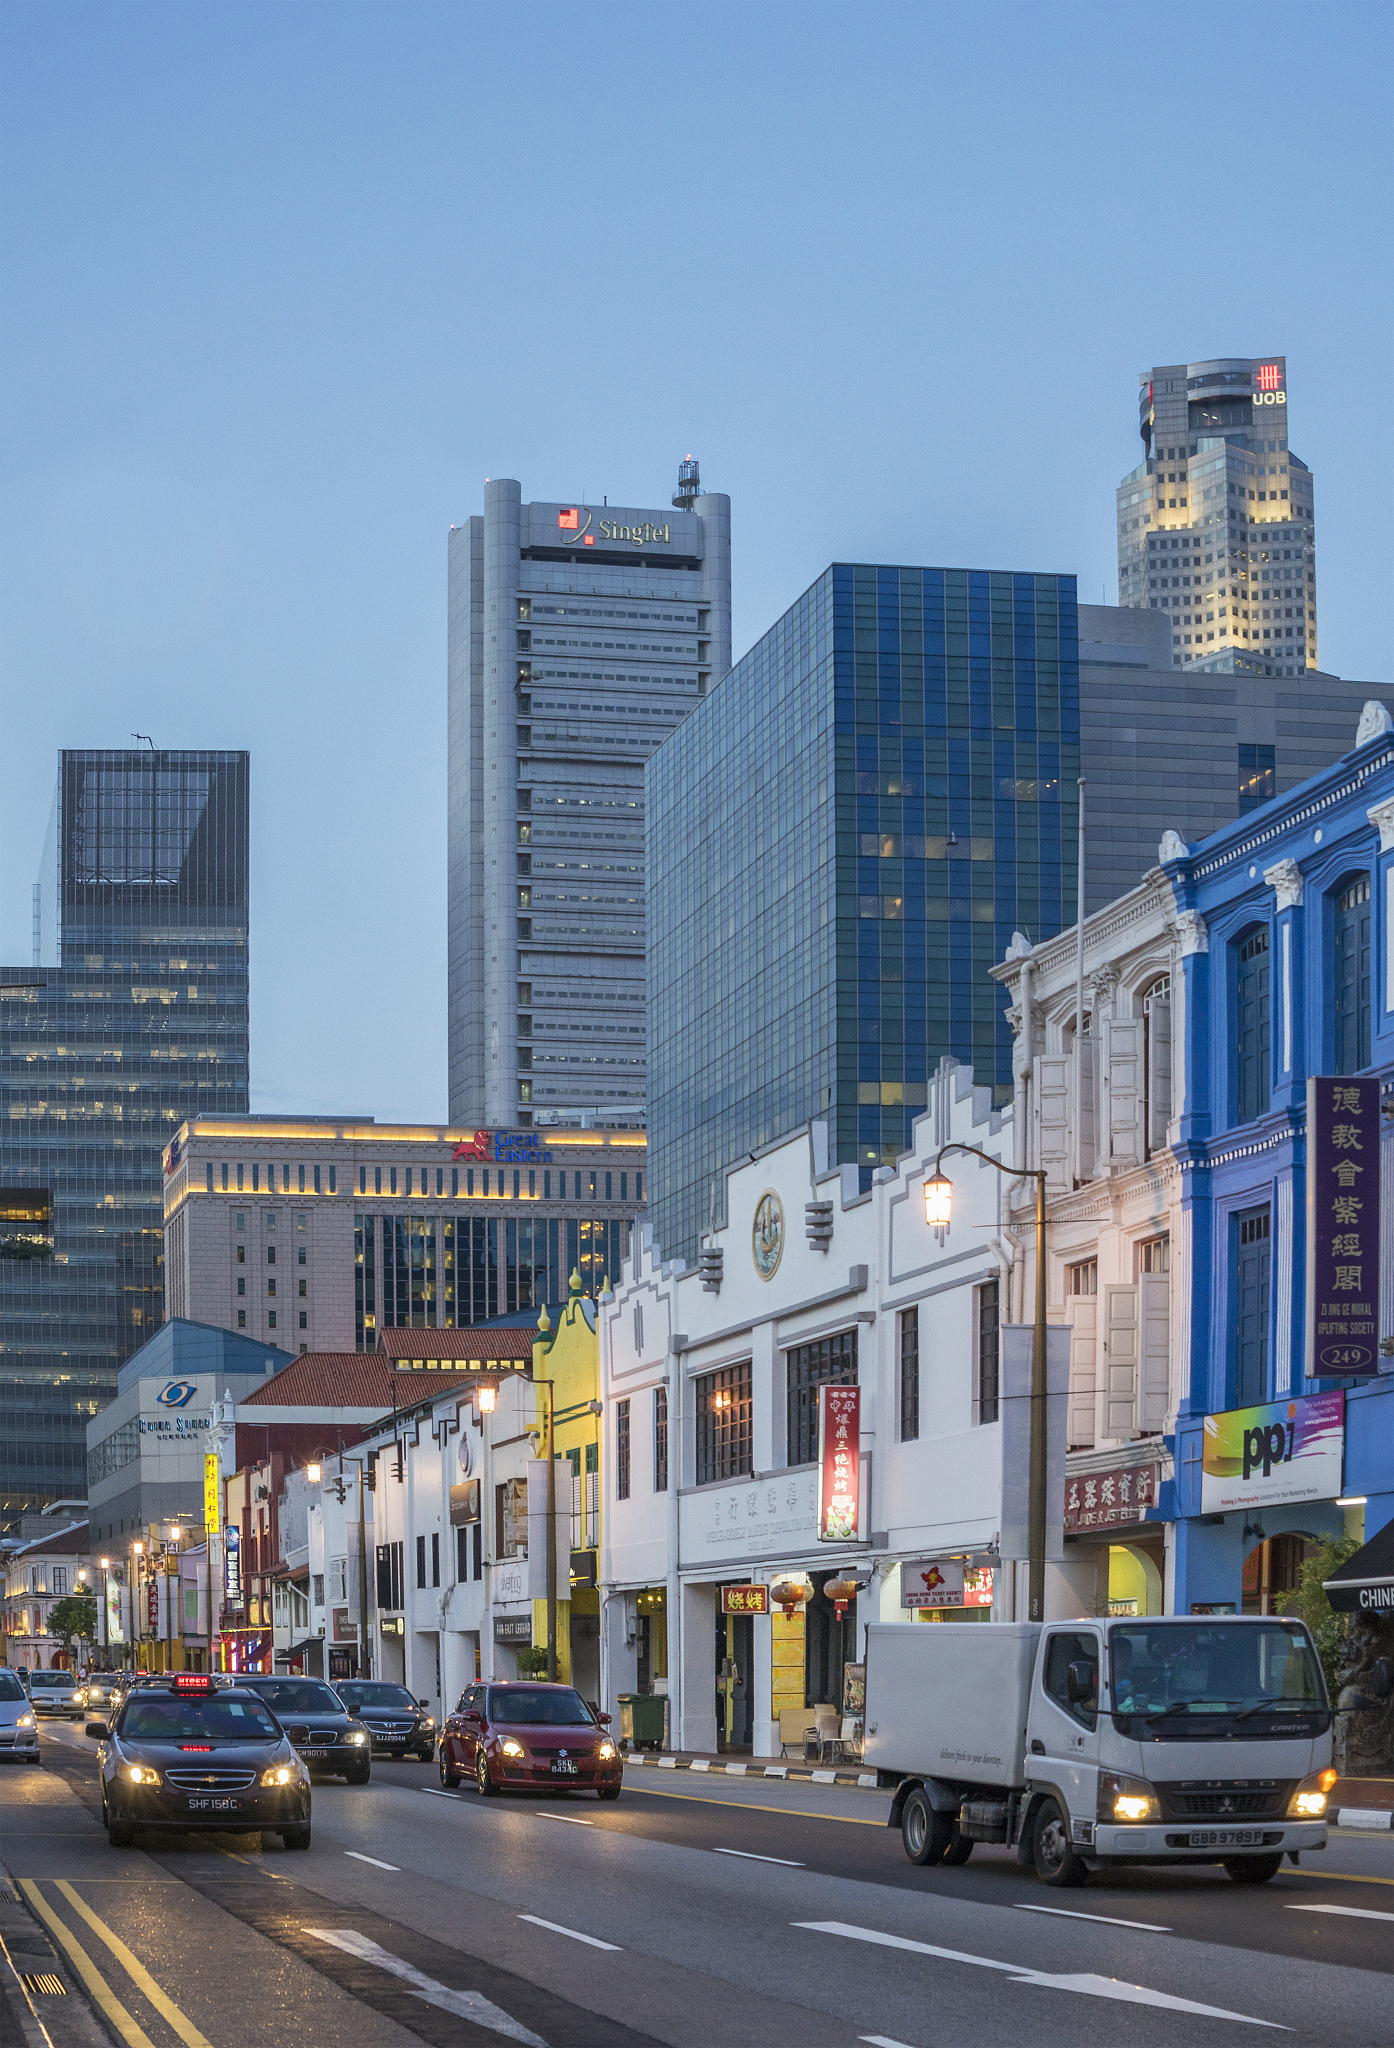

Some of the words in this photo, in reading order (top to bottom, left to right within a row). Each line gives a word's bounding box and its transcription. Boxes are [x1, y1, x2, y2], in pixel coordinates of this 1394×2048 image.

[1252, 391, 1287, 406] UOB
[599, 520, 671, 546] SingTel
[495, 1130, 538, 1147] Great
[495, 1147, 553, 1163] Eastern
[1351, 1303, 1372, 1316] MORAL
[1317, 1322, 1349, 1335] UPLIFTING
[1350, 1322, 1375, 1335] SOCIETY
[1331, 1349, 1362, 1363] 249
[1237, 1495, 1260, 1504] Photography
[1288, 1489, 1306, 1498] Marketing
[1098, 1510, 1104, 1524] &
[727, 1589, 764, 1611] 烧烤
